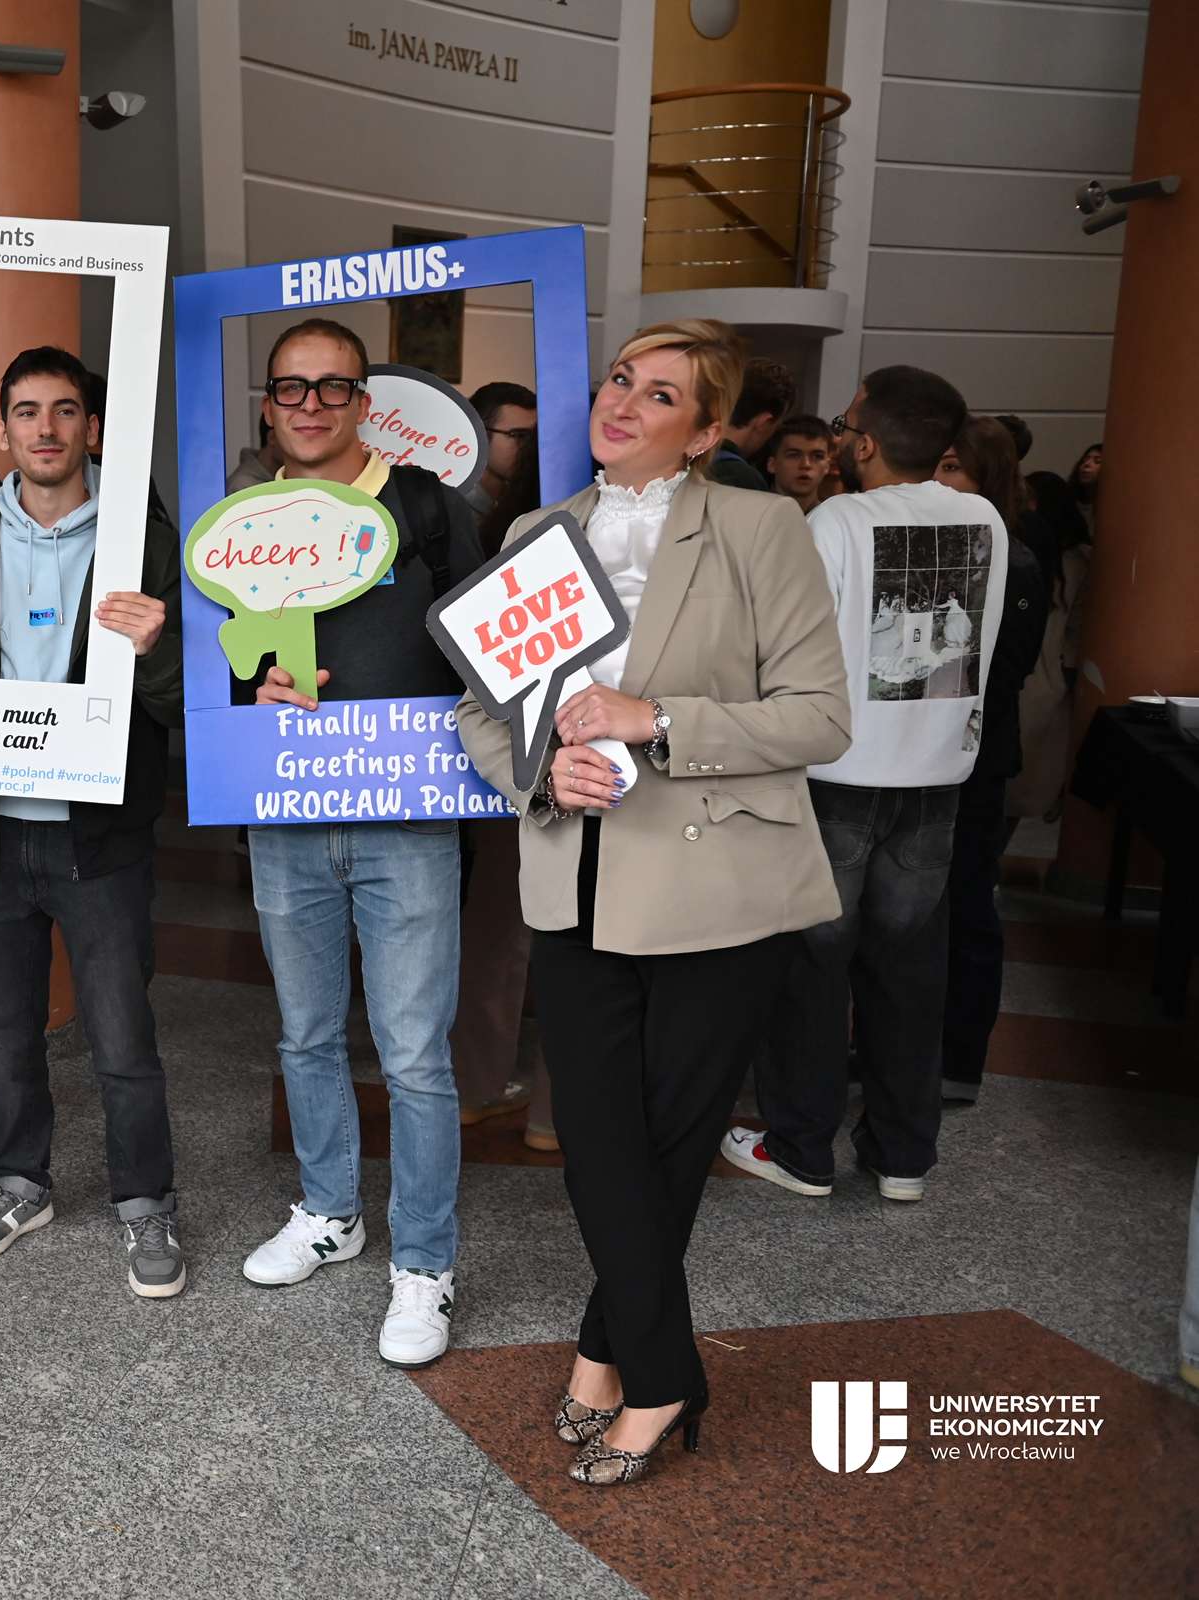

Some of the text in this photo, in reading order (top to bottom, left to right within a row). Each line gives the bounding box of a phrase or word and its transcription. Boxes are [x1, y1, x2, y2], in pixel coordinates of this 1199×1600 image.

[347, 23, 518, 83] im. JANA PAWŁA II
[59, 256, 83, 269] and
[86, 256, 144, 272] Business
[281, 245, 466, 306] ERASMUS+
[444, 437, 470, 458] to
[205, 538, 320, 569] cheers
[500, 566, 522, 599] I
[474, 570, 585, 655] LOVE
[495, 612, 583, 681] YOU
[2, 707, 58, 727] much
[276, 704, 378, 742] Finally
[3, 731, 49, 750] can!
[1, 765, 54, 781] #poland
[57, 769, 122, 785] #wroclaw
[275, 742, 474, 782] Greetings fro
[255, 787, 412, 821] WROCŁAW,
